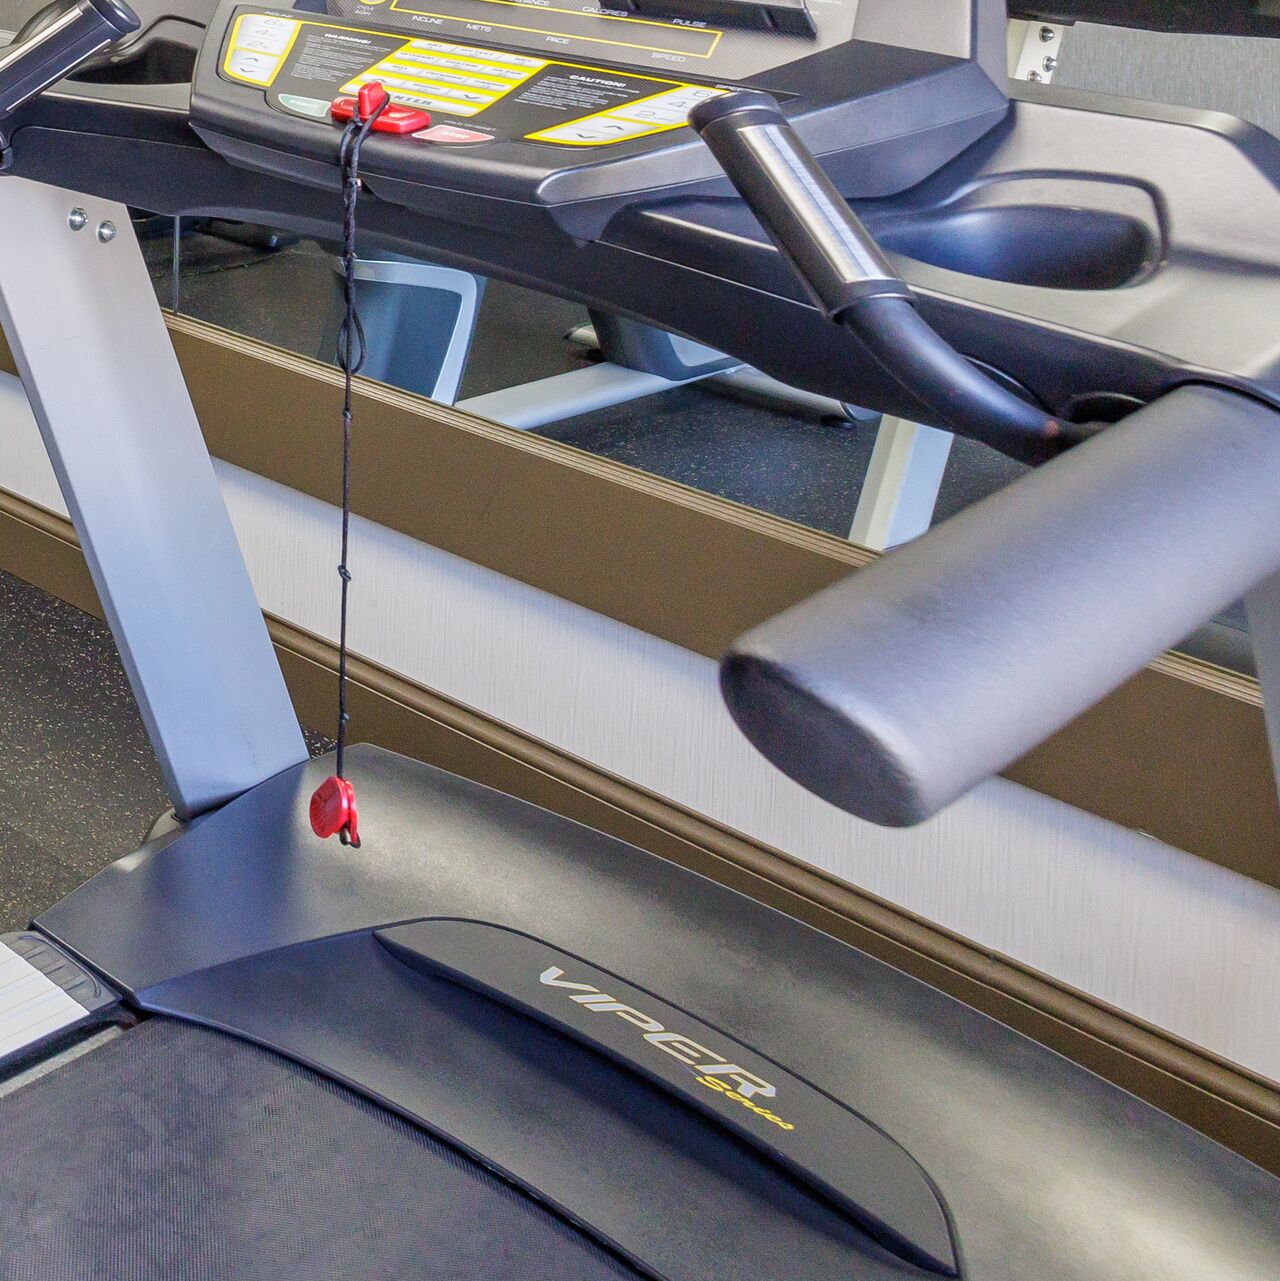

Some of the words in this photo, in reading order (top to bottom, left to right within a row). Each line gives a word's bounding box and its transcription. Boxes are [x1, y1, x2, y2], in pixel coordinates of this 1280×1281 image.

[582, 6, 629, 17] CALORIES
[411, 15, 444, 25] INCLINE
[672, 18, 707, 28] PULSE
[465, 23, 493, 33] METS
[324, 33, 372, 45] WARNING!
[546, 35, 570, 45] PACE
[651, 52, 687, 62] SPEED
[569, 74, 627, 88] CAUTION!
[394, 94, 433, 107] NTER
[539, 965, 777, 1098] VIPER
[694, 1075, 794, 1131] Series
